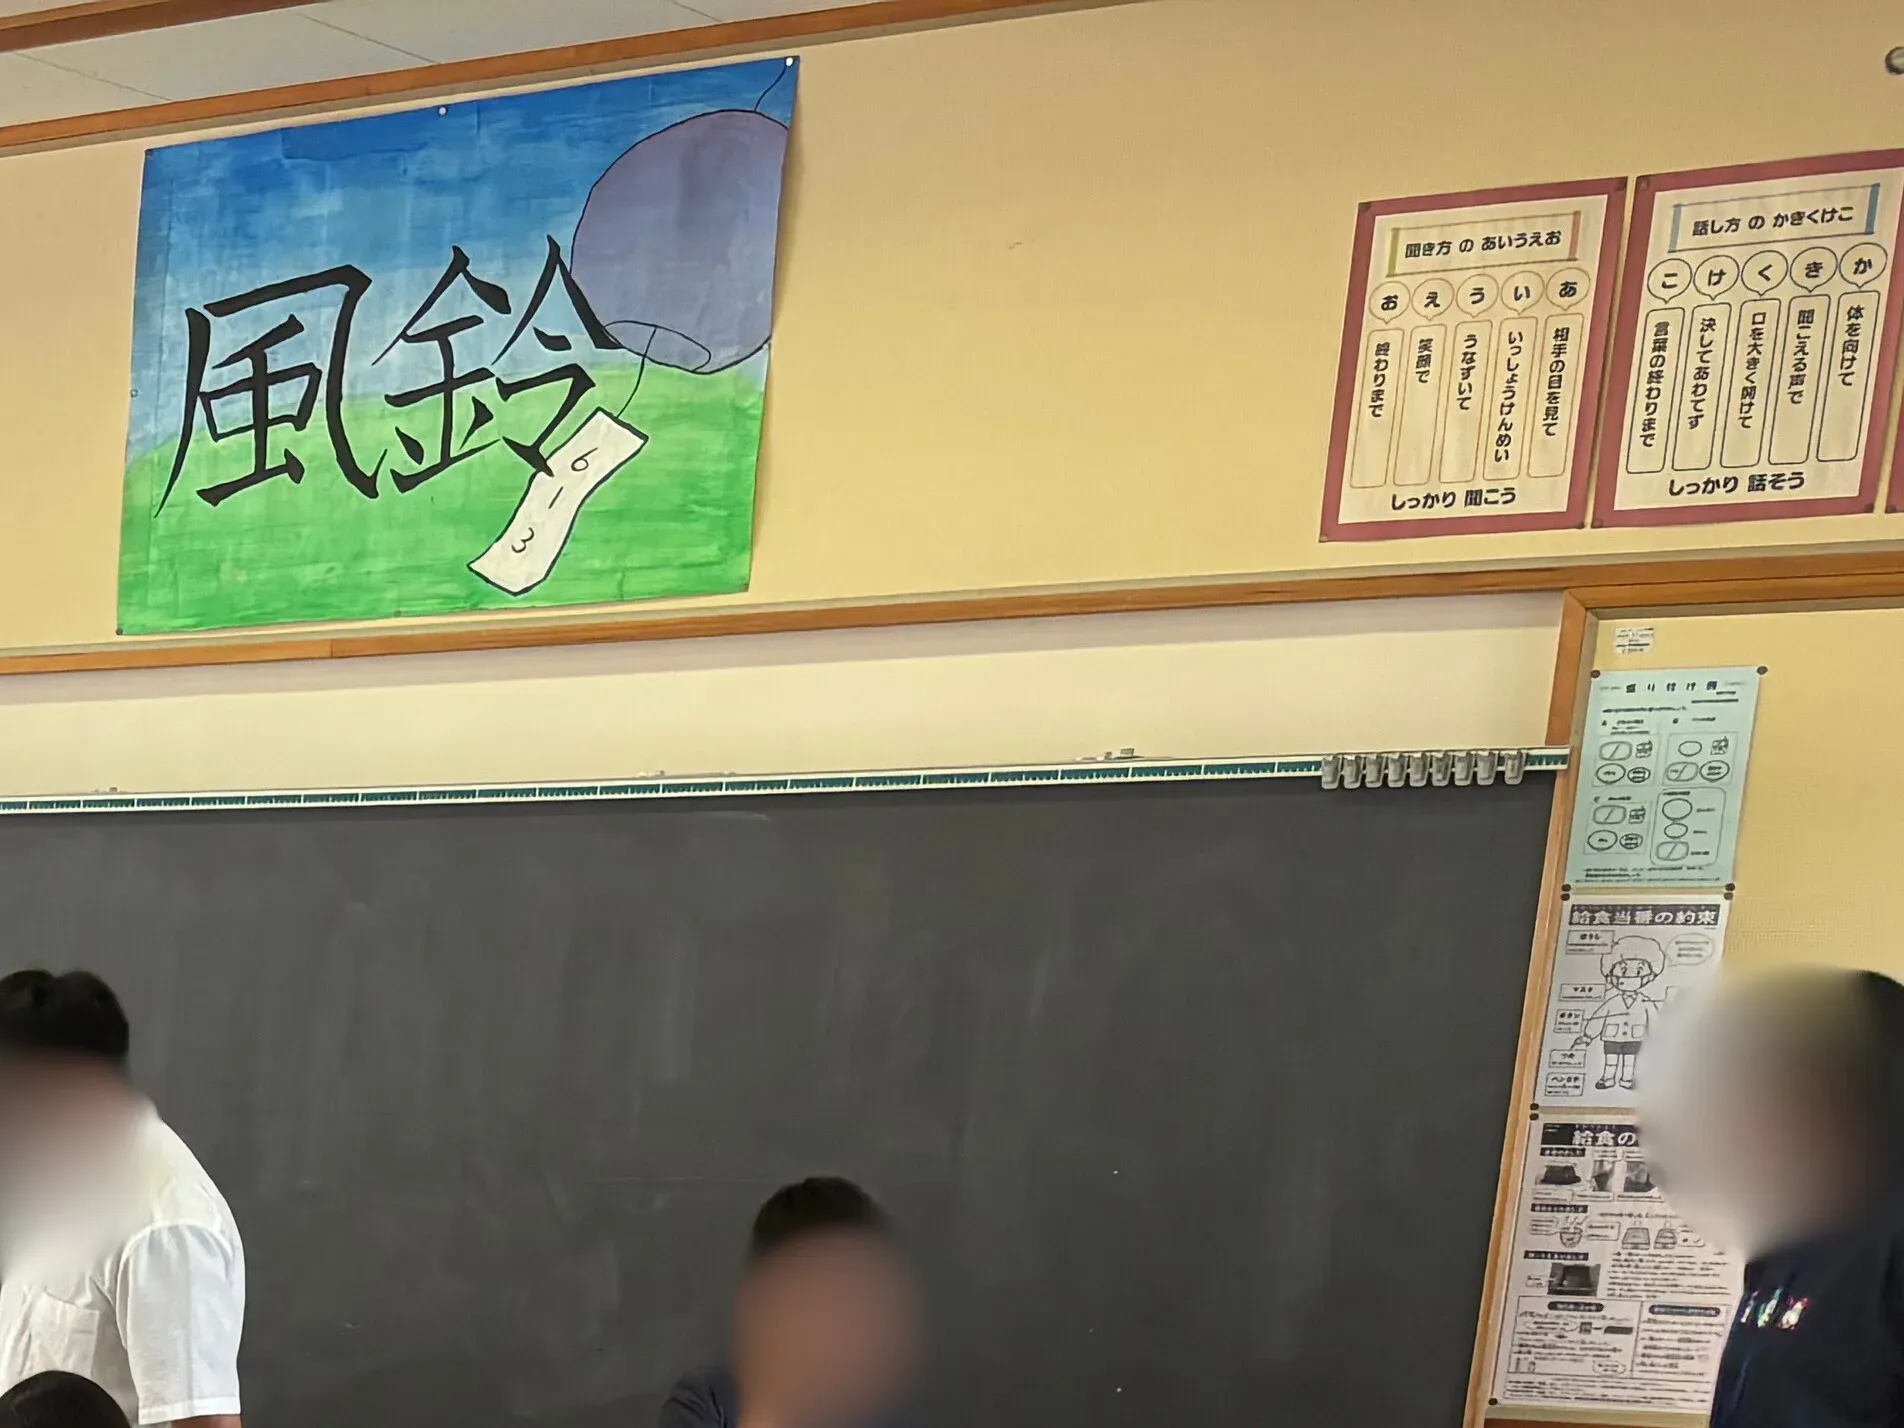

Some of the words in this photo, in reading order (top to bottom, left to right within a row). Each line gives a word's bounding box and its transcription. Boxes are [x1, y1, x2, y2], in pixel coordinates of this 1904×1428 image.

[1692, 218, 1740, 236] 話し方
[1748, 215, 1765, 229] の
[1773, 206, 1854, 228] かきくけこ
[1405, 240, 1451, 258] 聞き方
[1459, 238, 1474, 253] の
[1482, 231, 1561, 251] あいうえお
[1708, 269, 1726, 285] け
[1758, 265, 1773, 281] く
[1805, 261, 1823, 278] き
[1854, 258, 1872, 274] か
[1514, 286, 1530, 300] い
[1559, 281, 1577, 298] あ
[1661, 273, 1678, 289] こ
[1381, 294, 1397, 311] お
[1424, 291, 1440, 308] え
[1469, 287, 1485, 304] う
[1788, 310, 1814, 404] 聞こえる声で
[1839, 304, 1865, 386] 体を向けて
[1416, 339, 1433, 383] 笑顔で
[1457, 334, 1477, 410] うなずいて
[1688, 318, 1717, 429] 決してあわてず
[1739, 312, 1765, 428] 口を大きく開けて
[154, 234, 624, 519] 風鈴
[1369, 342, 1390, 417] 終わりまで
[1543, 327, 1569, 436] 相手の目を見て
[1639, 321, 1670, 447] 言葉の終わりまで
[1494, 331, 1523, 463] いっしょうけんめい
[1668, 475, 1739, 496] しっかり
[1747, 472, 1805, 492] 話そう
[1392, 491, 1456, 510] しっかり
[1464, 488, 1516, 508] 聞こう
[1570, 908, 1718, 925] 給食当番の約束
